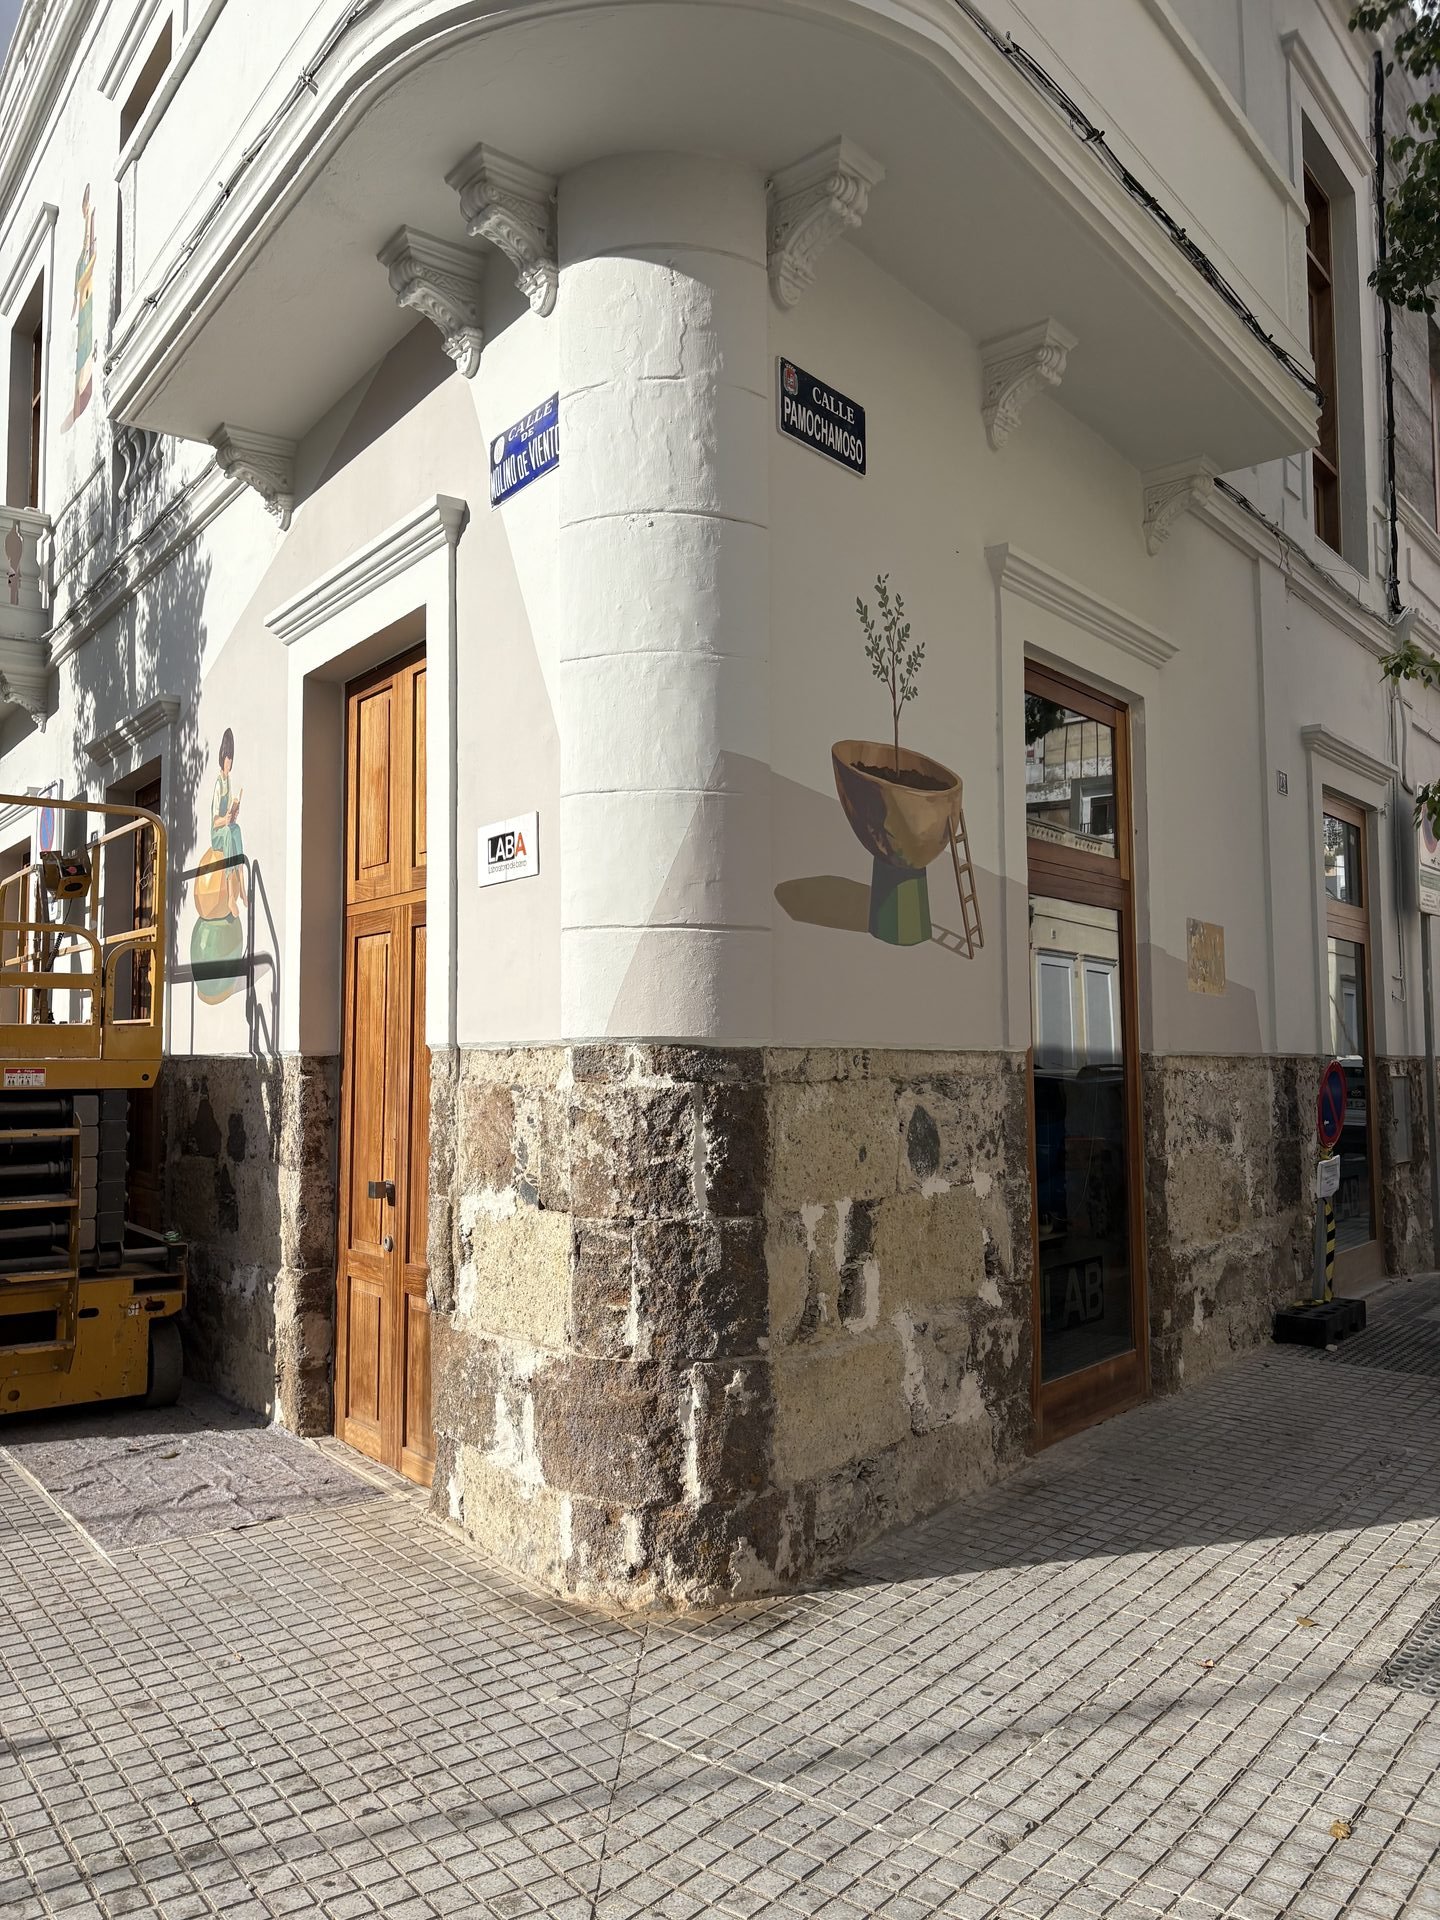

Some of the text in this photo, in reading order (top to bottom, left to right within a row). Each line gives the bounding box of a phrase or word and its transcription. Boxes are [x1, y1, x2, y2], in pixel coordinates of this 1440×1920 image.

[508, 399, 554, 442] CALLE
[813, 387, 855, 424] CALLE
[520, 425, 535, 442] DE
[784, 396, 863, 464] PAMOCHAMOSO
[517, 450, 530, 480] DE
[488, 831, 527, 863] LABA
